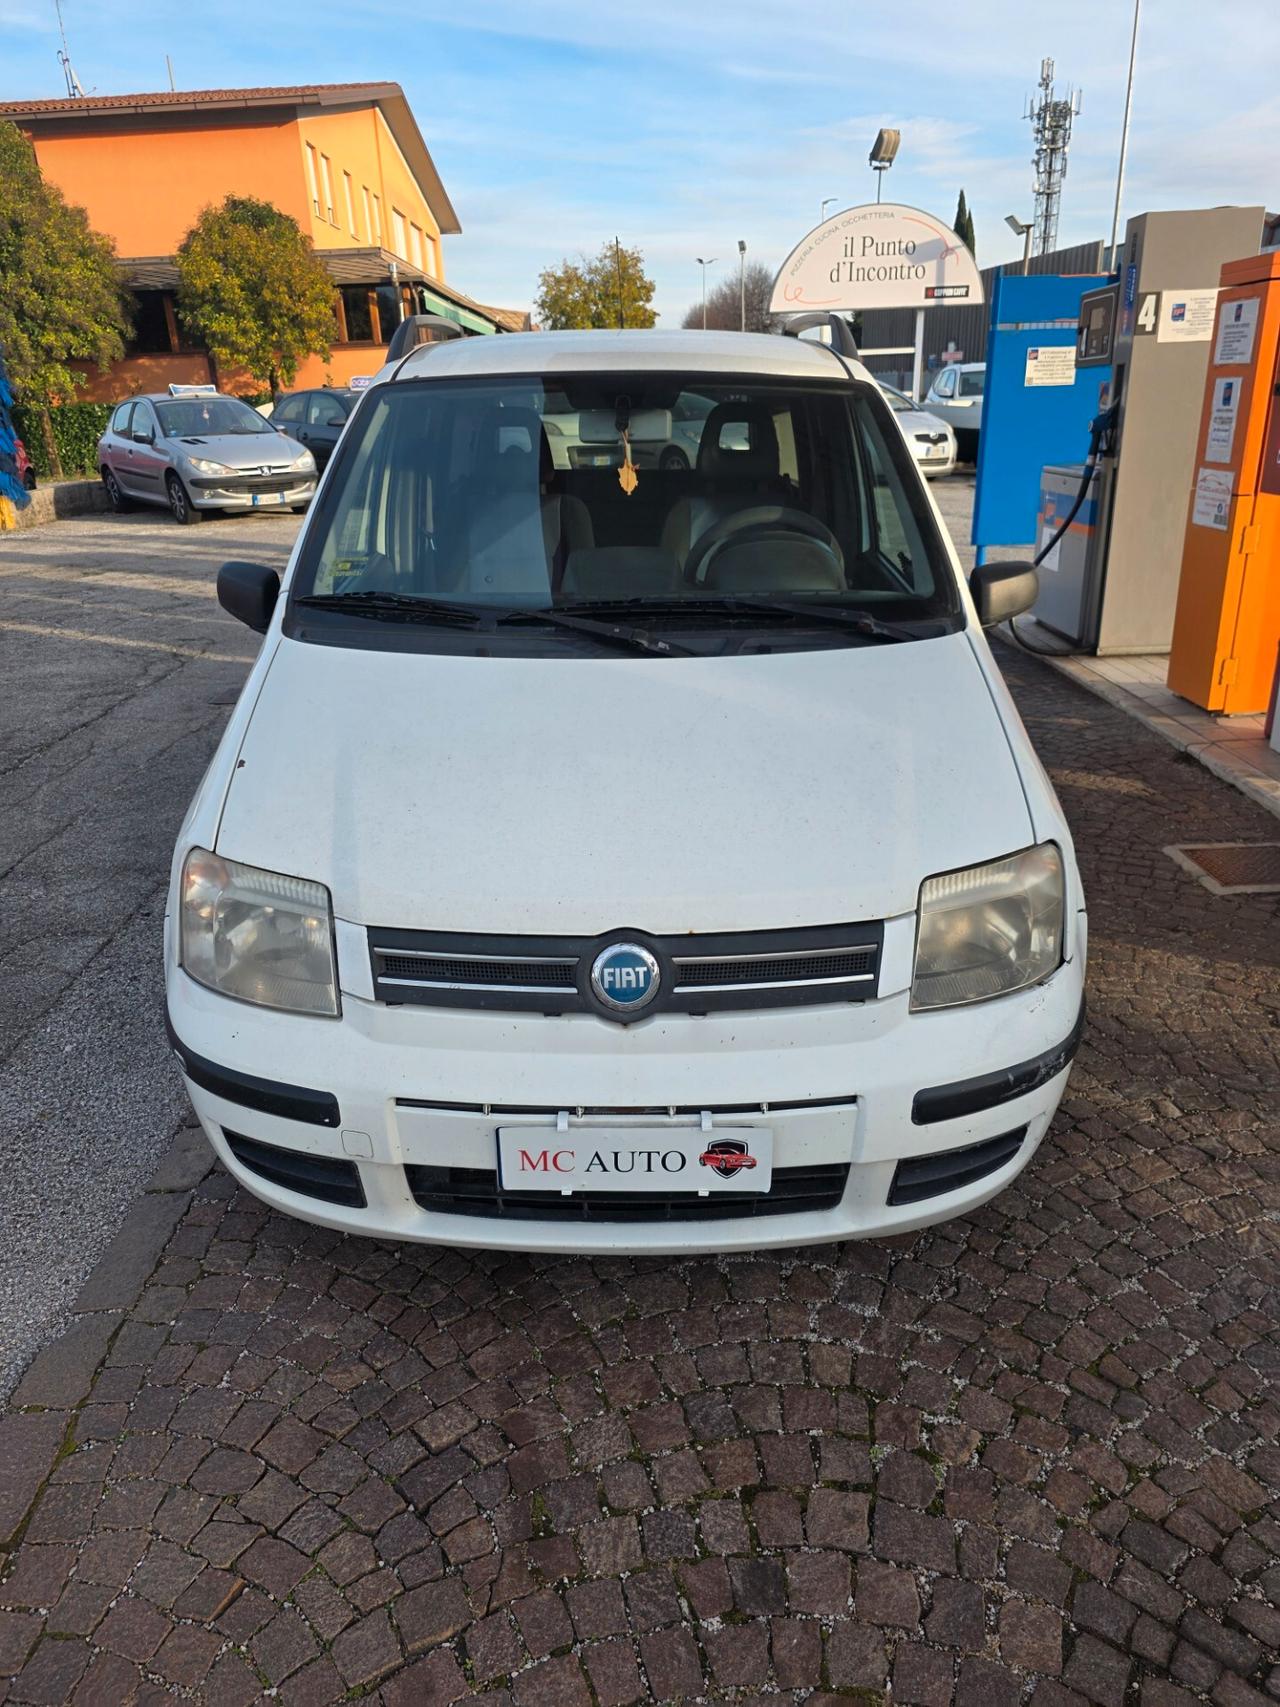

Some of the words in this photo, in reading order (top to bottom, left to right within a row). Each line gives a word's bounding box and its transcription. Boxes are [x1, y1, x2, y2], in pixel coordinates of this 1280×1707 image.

[843, 236, 855, 258] il
[862, 236, 916, 258] Punto
[829, 260, 926, 283] d'Incontro
[1137, 294, 1157, 332] 4
[603, 966, 647, 989] FIAT
[518, 1149, 575, 1173] MC
[584, 1149, 687, 1174] AUTO
